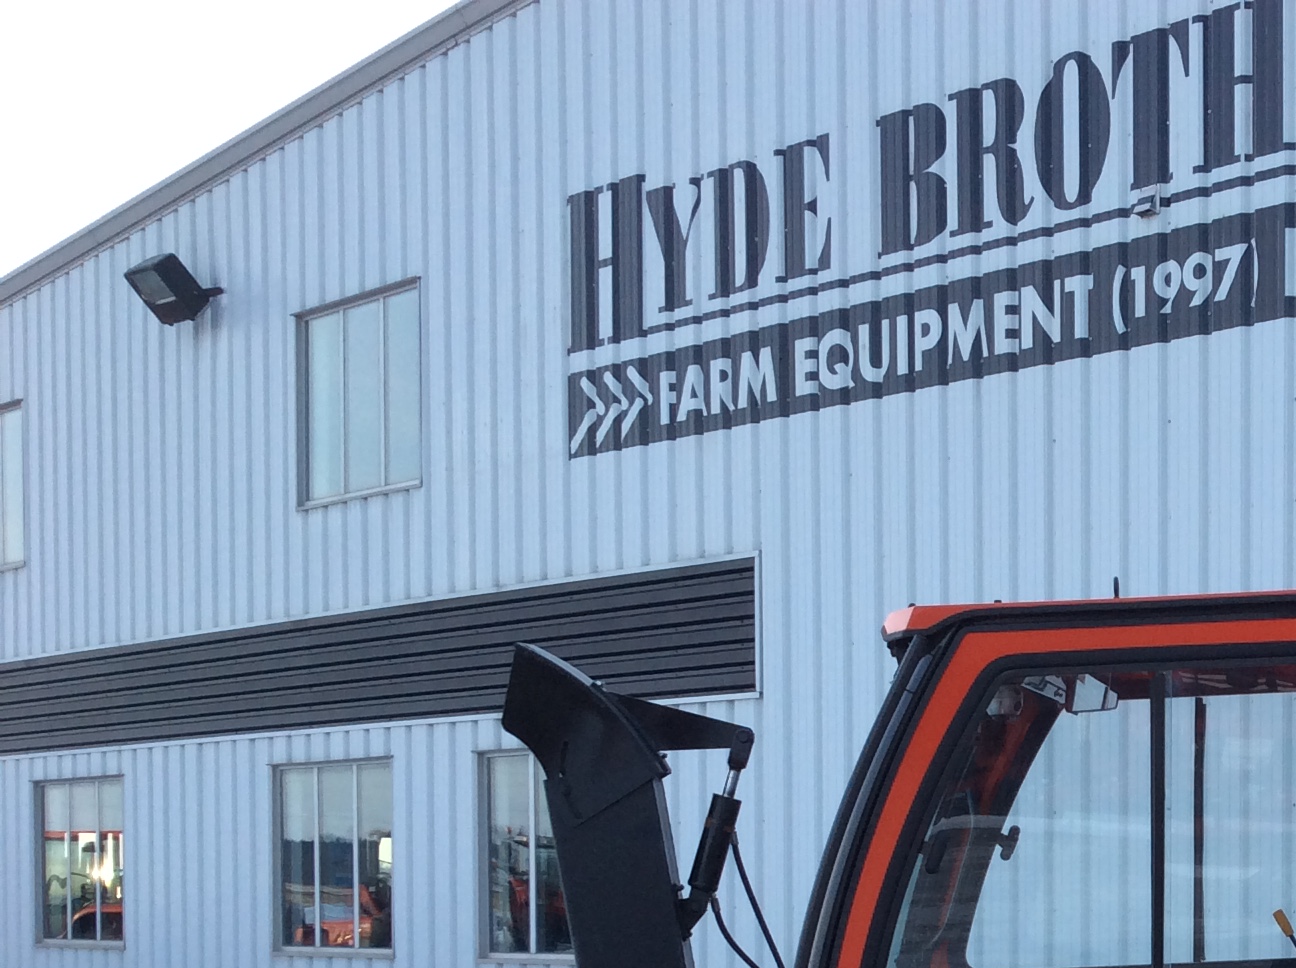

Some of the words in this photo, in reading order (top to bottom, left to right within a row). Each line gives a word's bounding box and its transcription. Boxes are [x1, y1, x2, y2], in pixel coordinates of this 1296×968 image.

[566, 132, 832, 357] HYDE
[658, 346, 778, 426] FARM
[793, 273, 1094, 398] EQUIPMENT
[1112, 238, 1259, 334] (1997)
